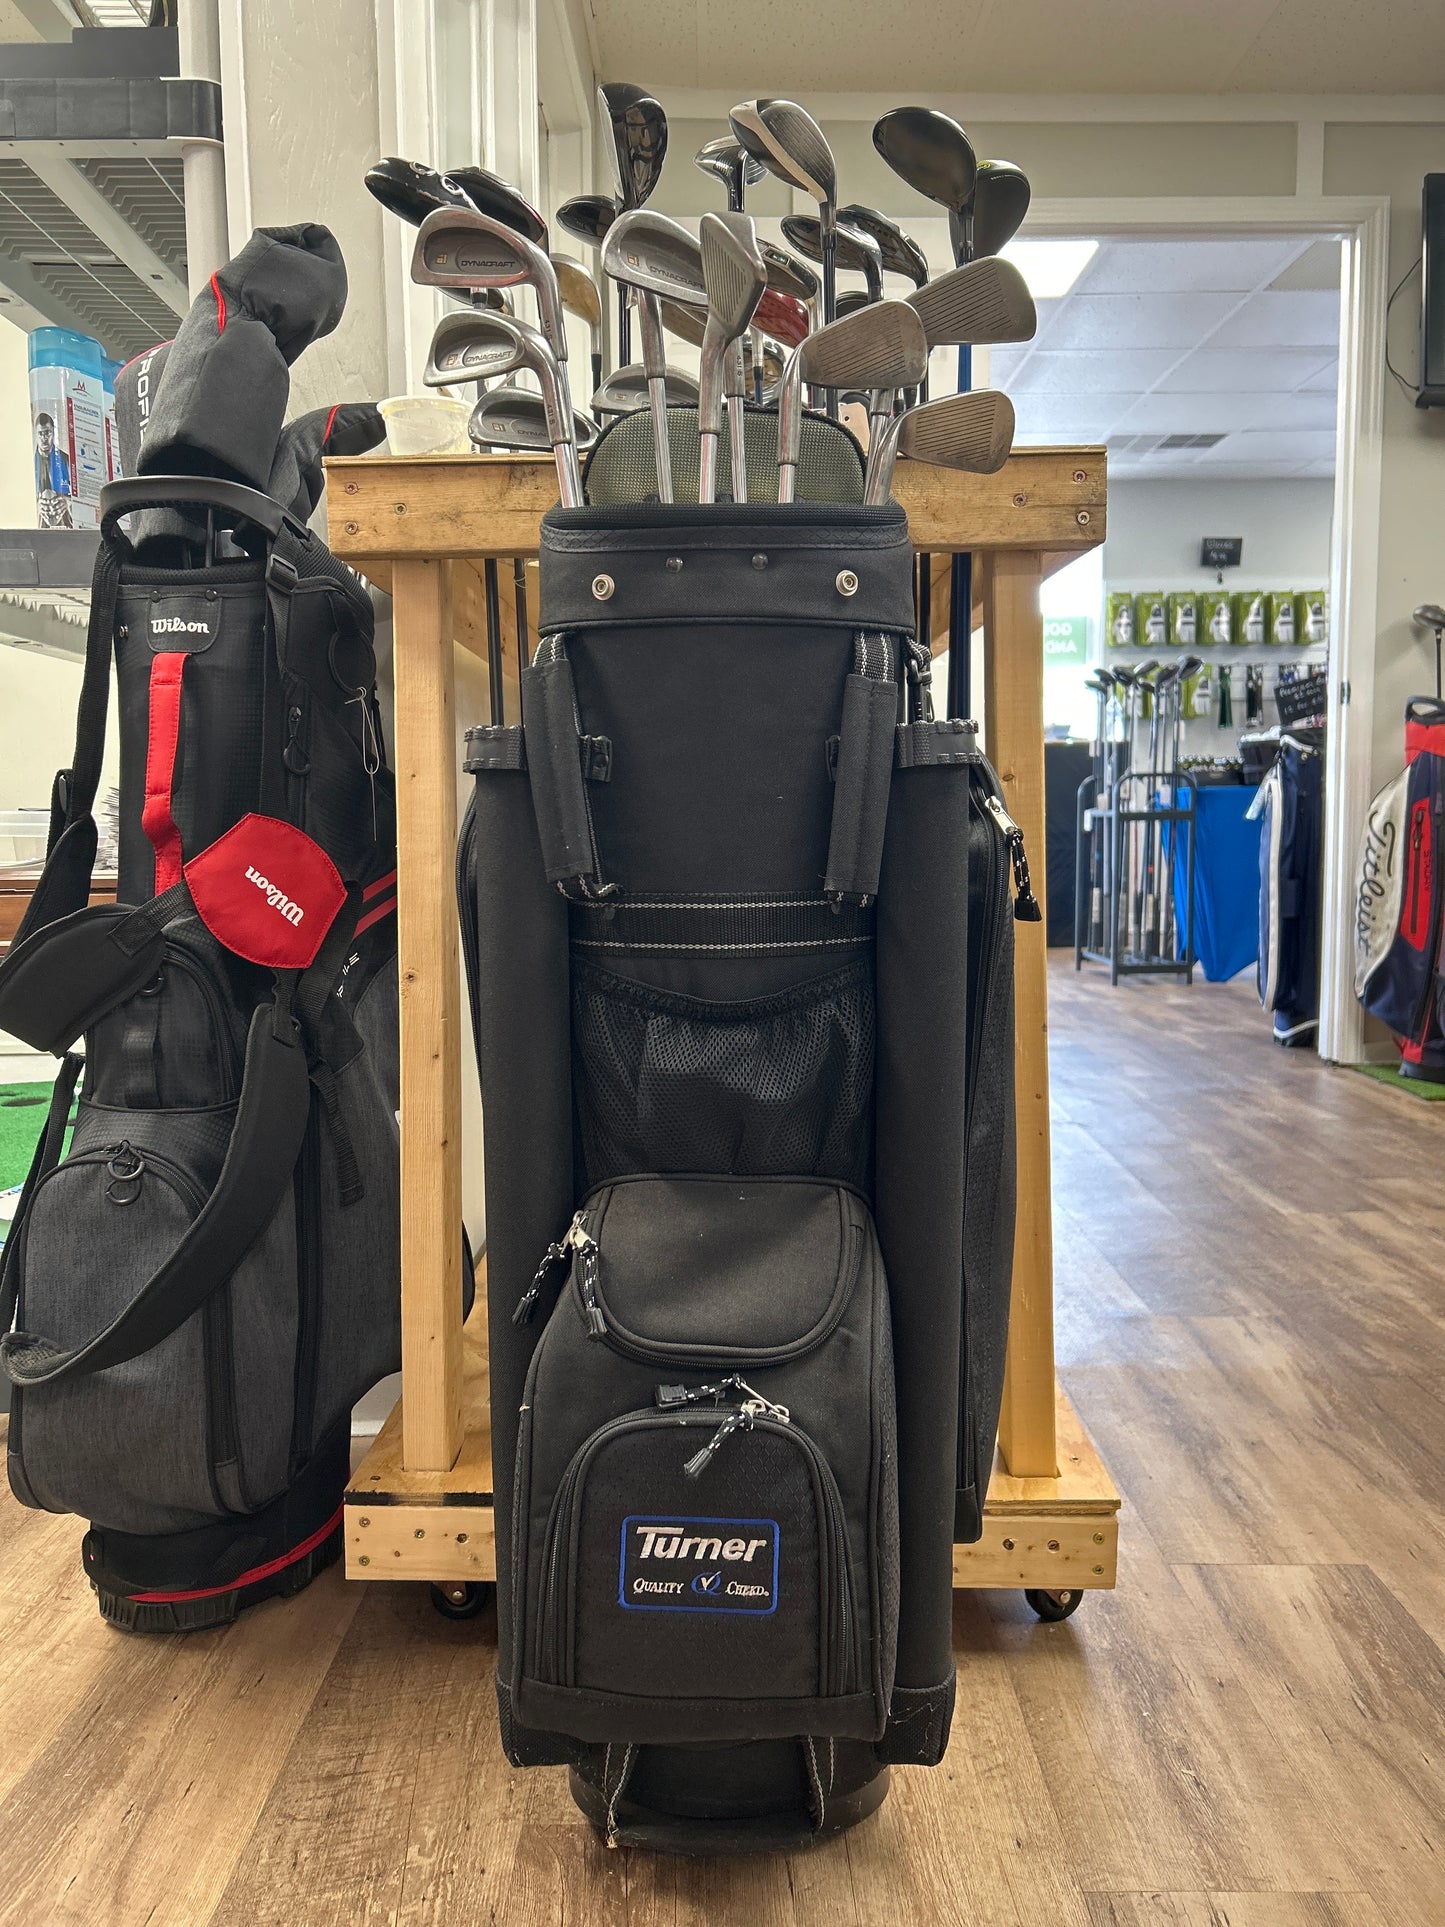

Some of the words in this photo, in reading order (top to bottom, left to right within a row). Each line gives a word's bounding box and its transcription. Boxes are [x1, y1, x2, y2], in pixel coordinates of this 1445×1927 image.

[461, 260, 515, 268] DYNACRAFT
[465, 350, 513, 363] DYNACRAFT
[151, 616, 210, 634] Wilson
[1356, 810, 1396, 957] Titleist
[244, 865, 304, 927] Wilson
[636, 1526, 768, 1562] Turner
[632, 1577, 684, 1595] QUALITY
